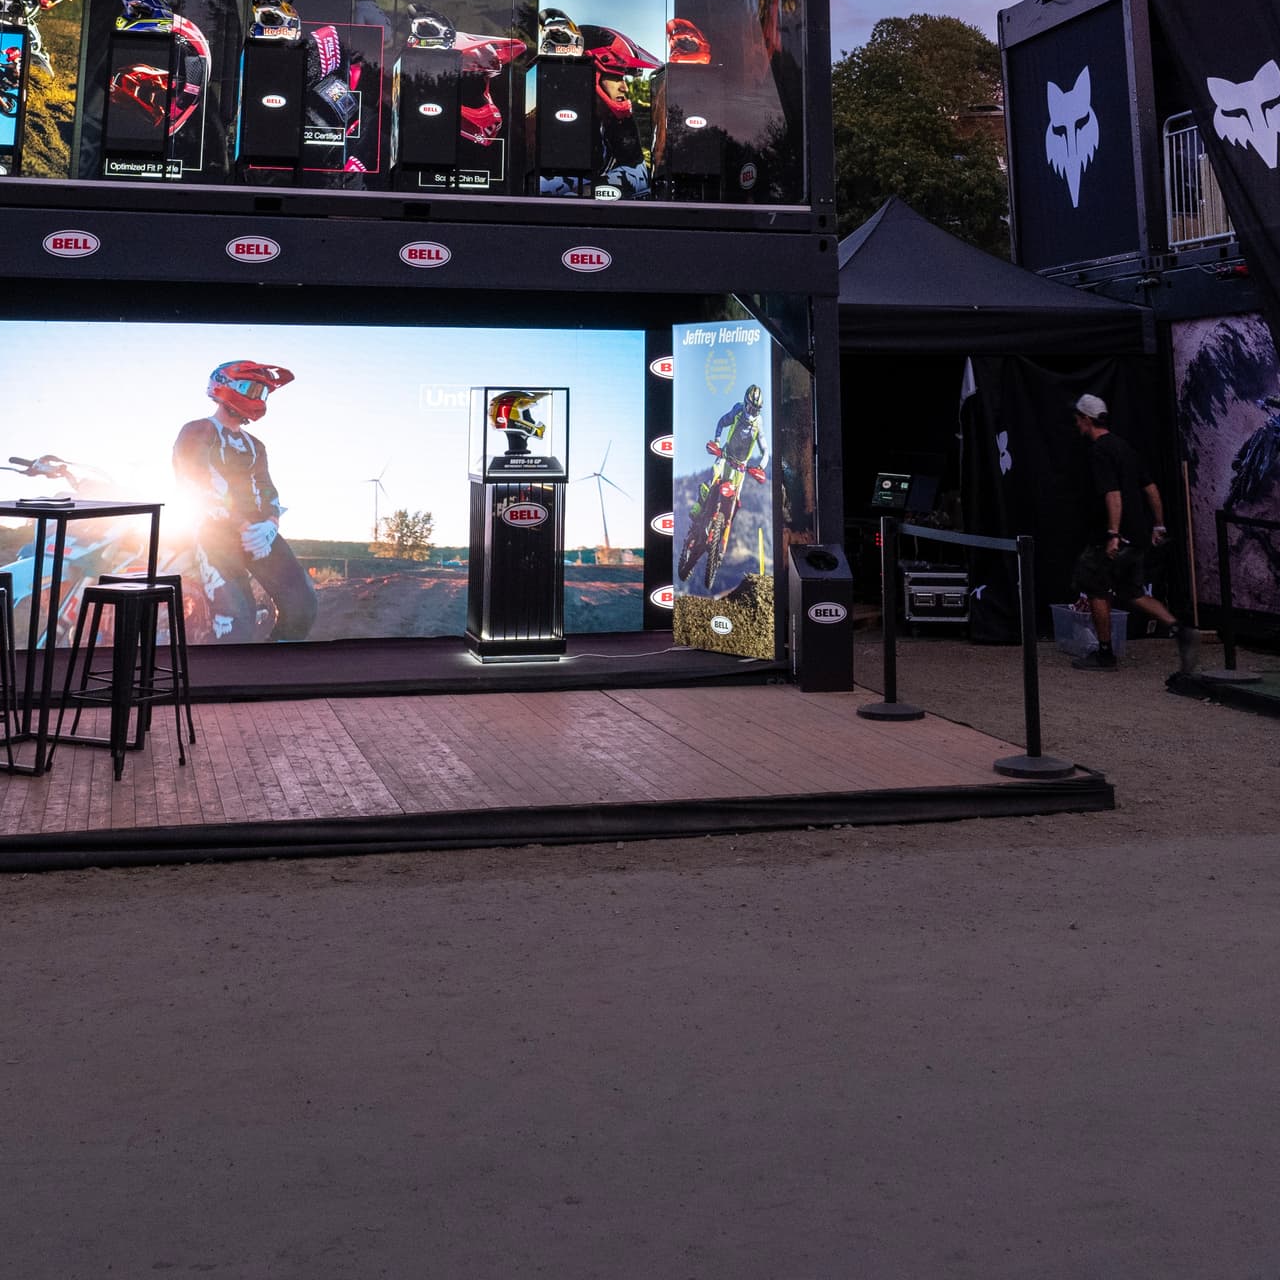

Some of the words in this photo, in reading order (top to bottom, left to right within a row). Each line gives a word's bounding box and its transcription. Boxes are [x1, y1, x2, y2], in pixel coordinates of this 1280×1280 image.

[110, 162, 146, 171] Optimized
[52, 237, 91, 250] BELL
[234, 243, 272, 256] BELL
[407, 248, 443, 261] BELL
[569, 253, 604, 266] BELL
[682, 329, 717, 346] Jeffrey
[718, 326, 760, 345] Herlings
[509, 506, 541, 522] BELL
[815, 609, 841, 617] BELL
[714, 621, 728, 629] BELL
